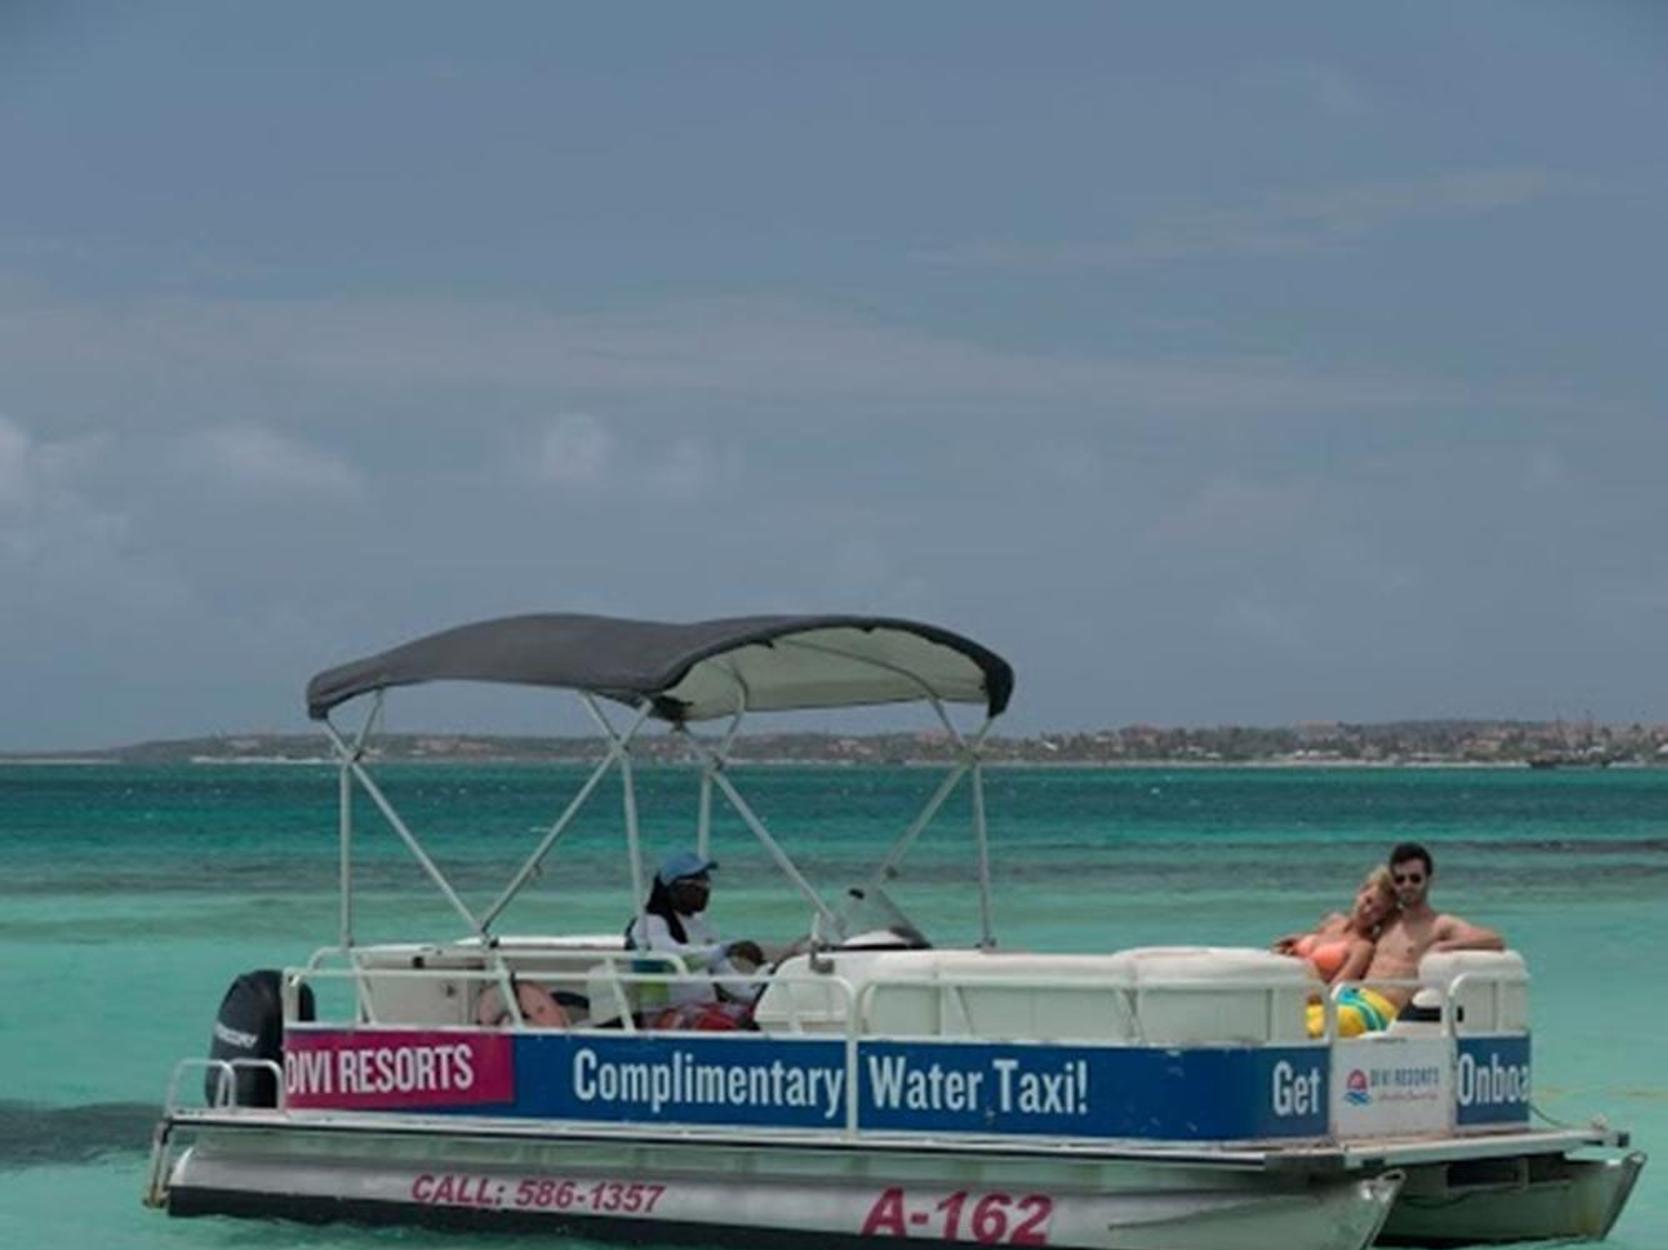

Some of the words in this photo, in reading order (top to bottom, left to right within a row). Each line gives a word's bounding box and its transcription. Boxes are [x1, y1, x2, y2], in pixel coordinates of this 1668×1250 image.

[285, 1051, 332, 1095] DIVI
[338, 1043, 474, 1094] RESORTS
[573, 1049, 845, 1118] Complimentary
[868, 1054, 983, 1111] Water
[993, 1058, 1088, 1115] Taxi!
[1273, 1060, 1322, 1116] Get
[411, 1174, 506, 1207] CALL:
[514, 1179, 665, 1214] 586-1357
[861, 1187, 1053, 1245] A-162
